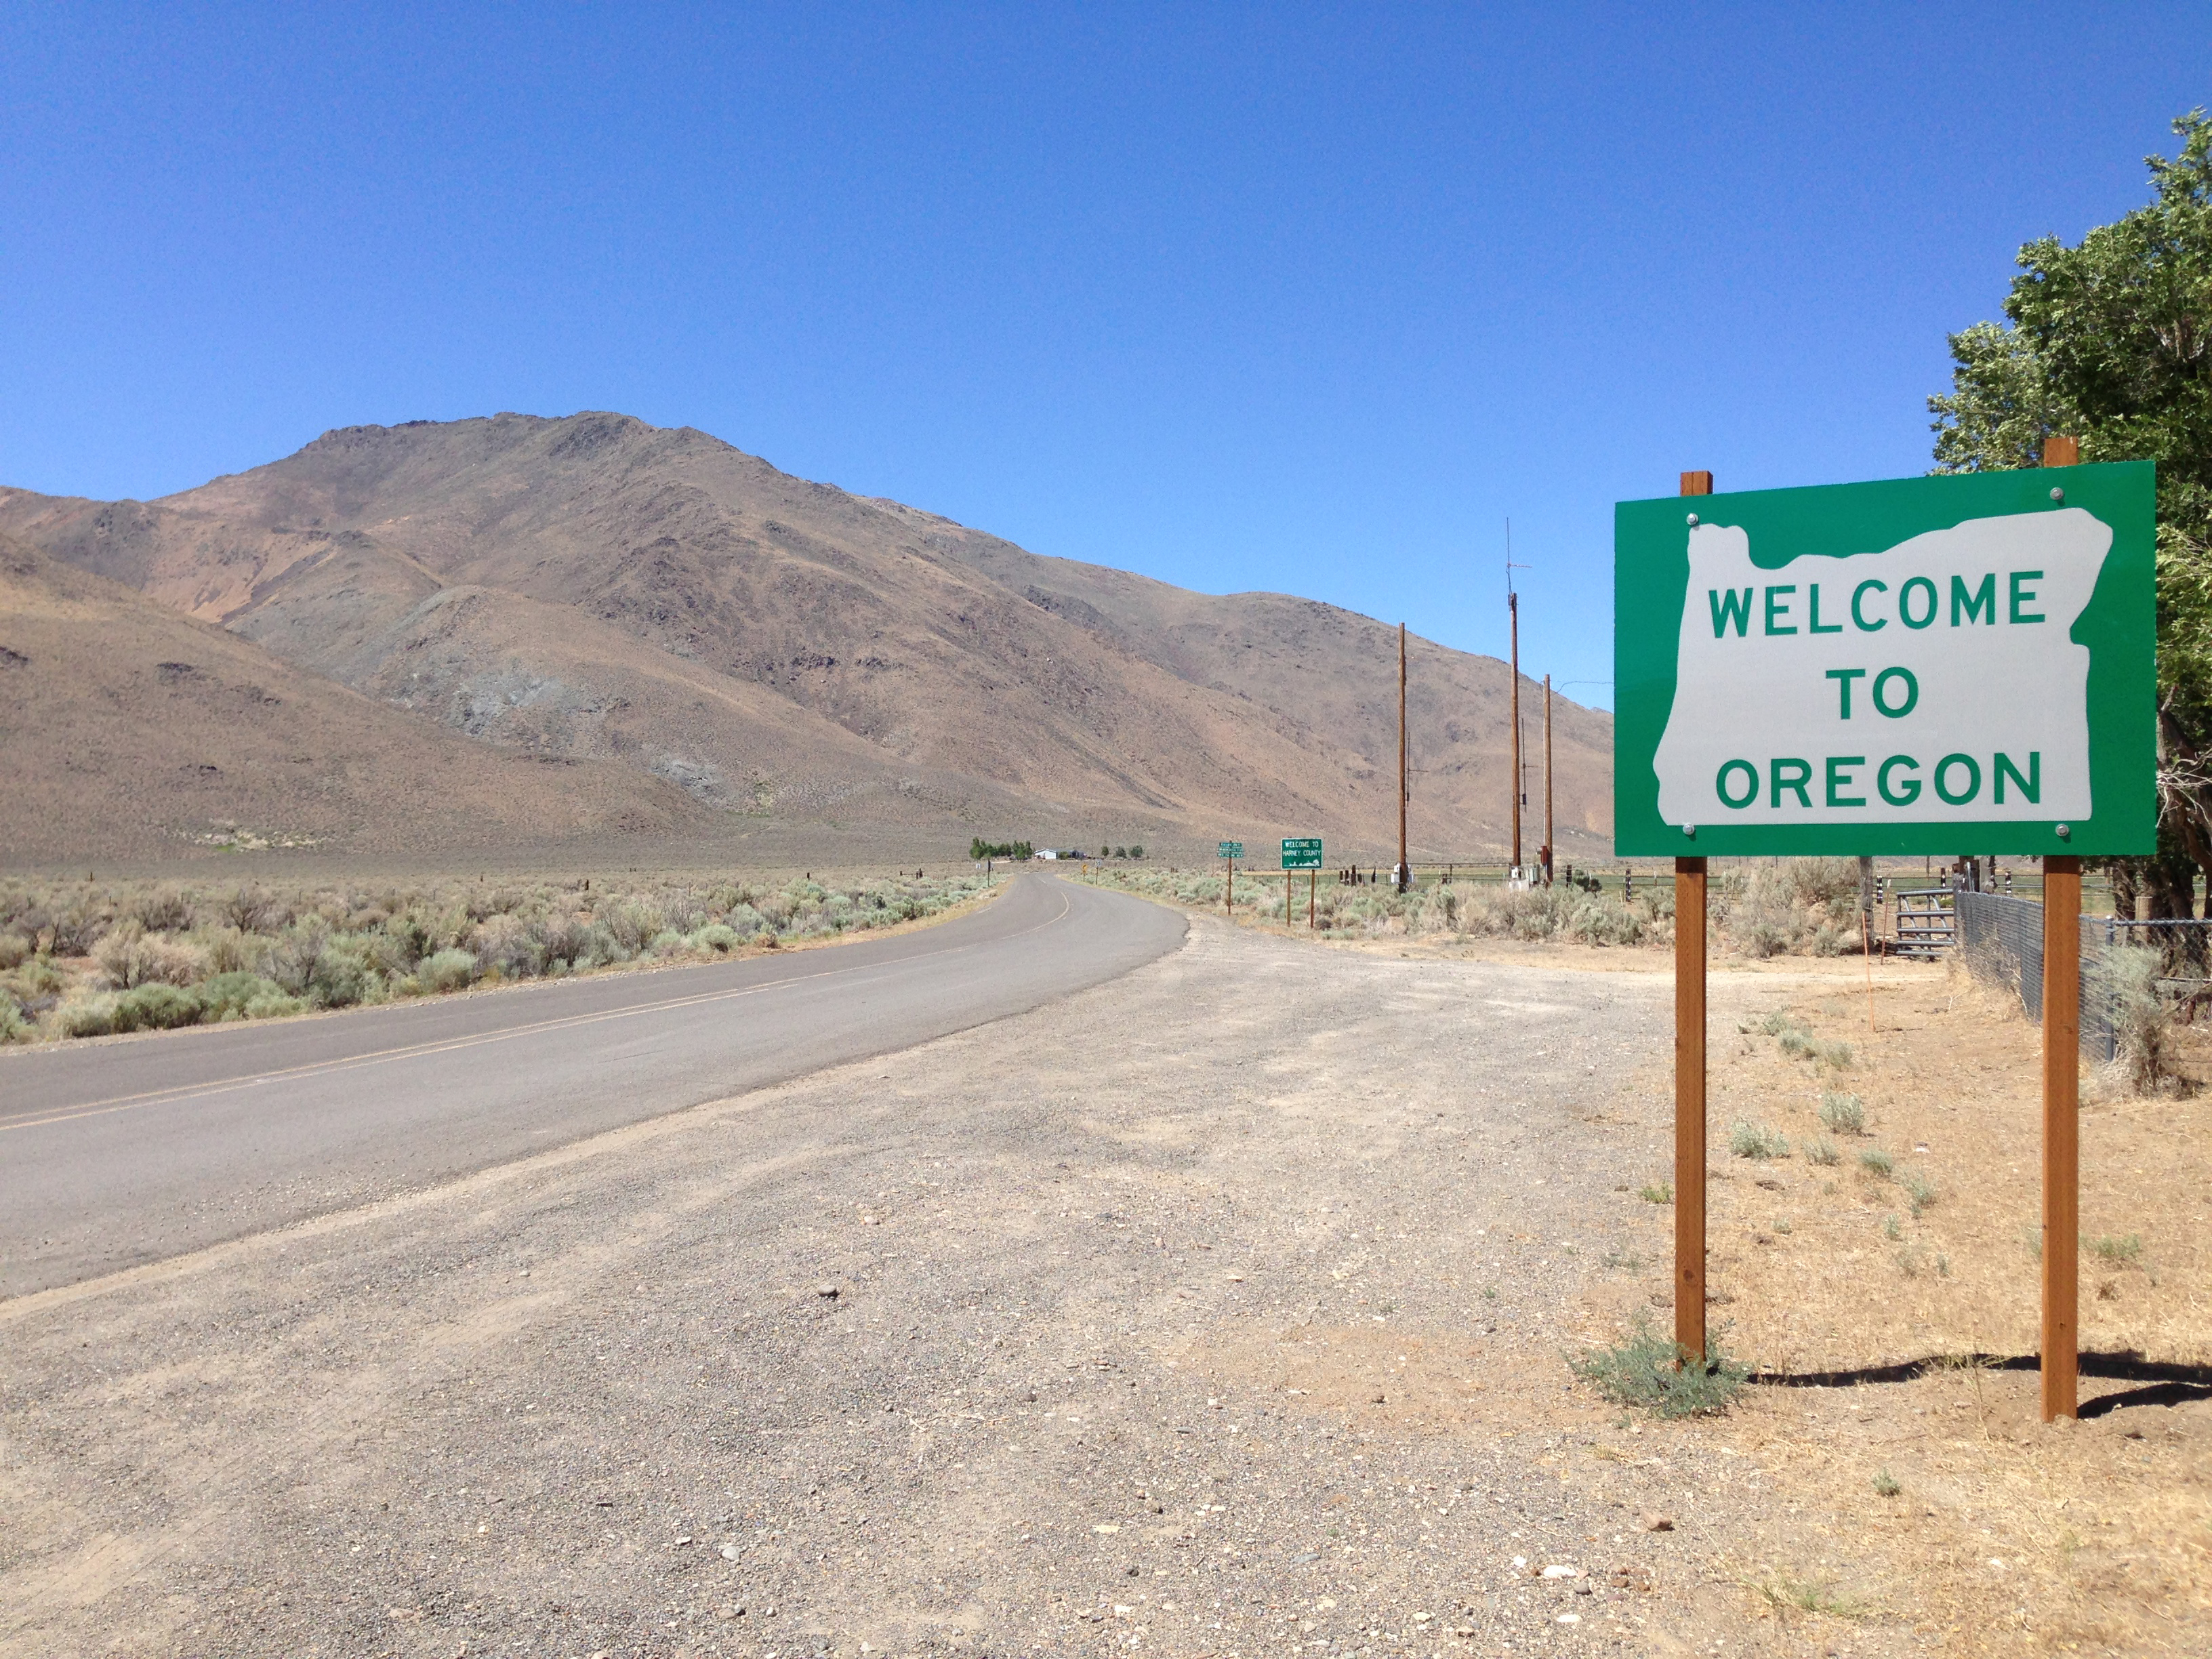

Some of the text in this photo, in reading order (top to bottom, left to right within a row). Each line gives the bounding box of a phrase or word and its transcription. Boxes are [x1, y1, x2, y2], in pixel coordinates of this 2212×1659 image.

[1708, 570, 2045, 639] WELCOME
[1826, 665, 1919, 720] TO
[1716, 751, 2041, 810] OREGON
